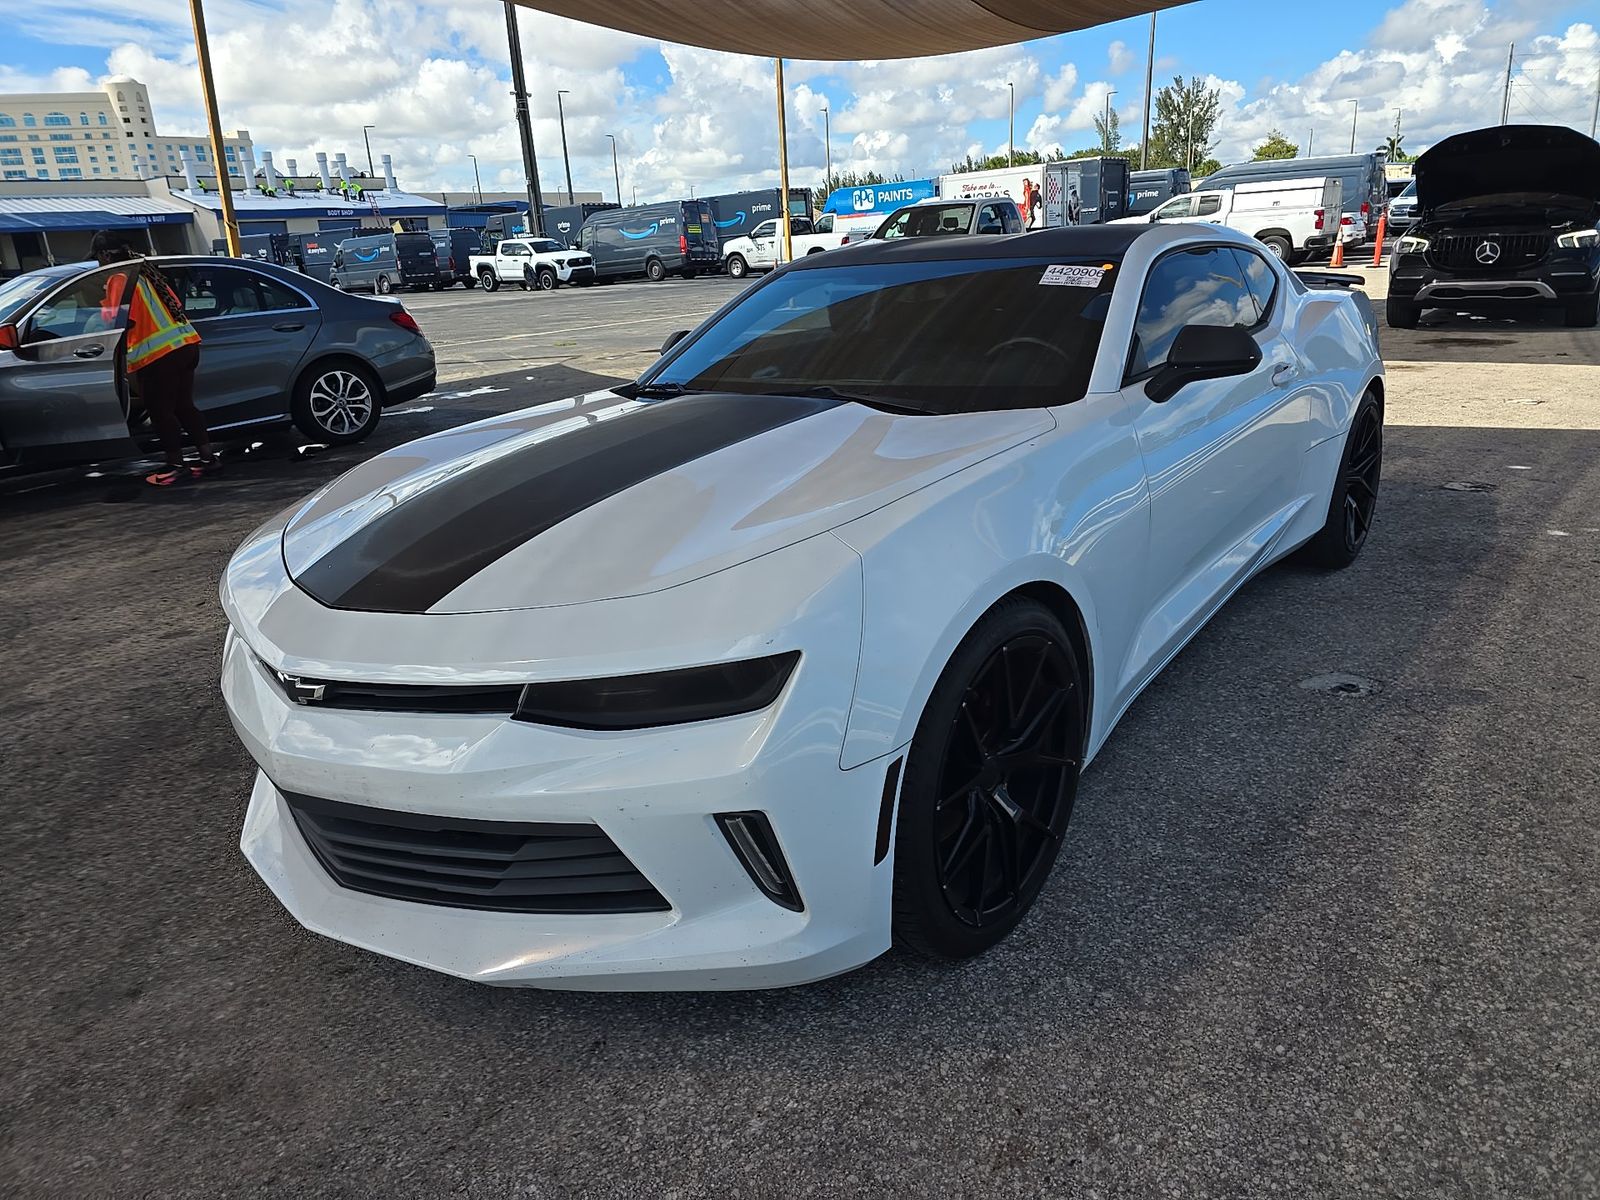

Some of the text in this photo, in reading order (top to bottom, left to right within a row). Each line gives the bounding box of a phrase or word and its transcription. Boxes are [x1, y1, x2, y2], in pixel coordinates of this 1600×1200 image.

[962, 184, 978, 192] Take
[878, 188, 913, 202] PAINTS
[1137, 189, 1159, 200] prime
[751, 203, 772, 214] prime
[557, 221, 571, 229] prime
[660, 217, 676, 227] prime
[1048, 267, 1106, 278] 4420906
